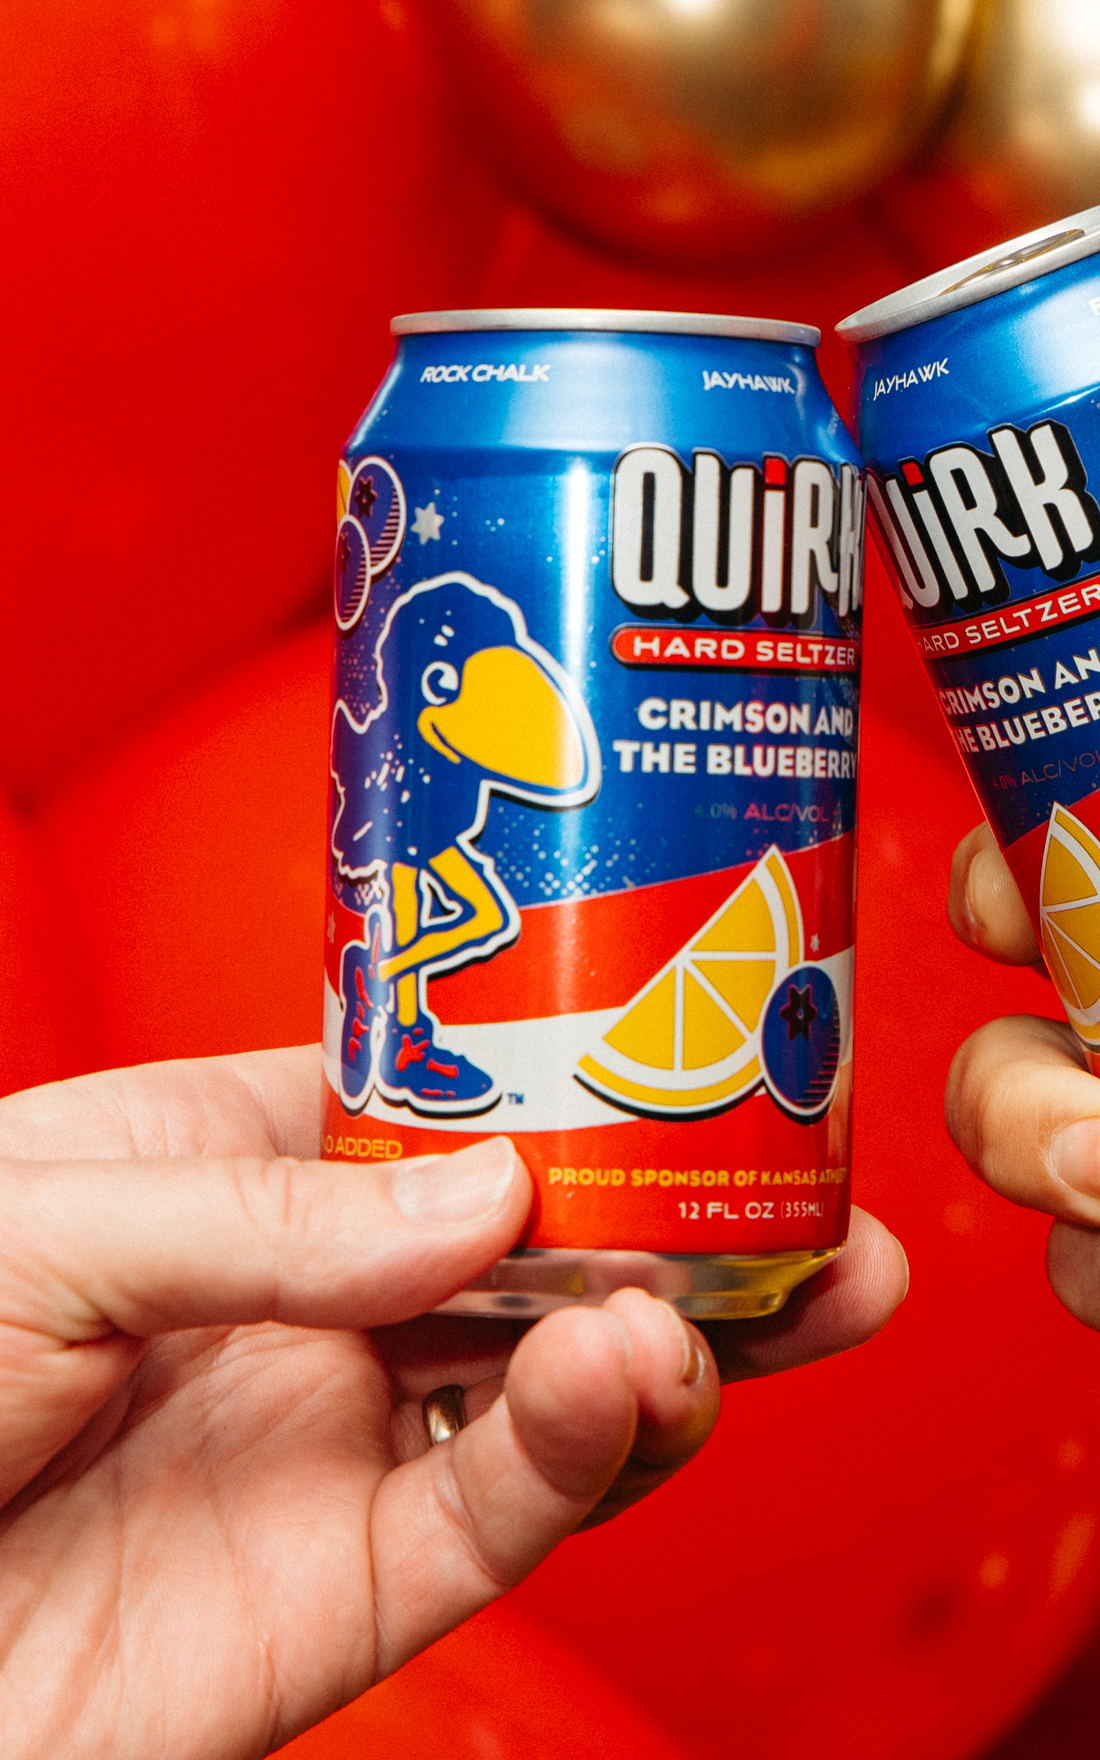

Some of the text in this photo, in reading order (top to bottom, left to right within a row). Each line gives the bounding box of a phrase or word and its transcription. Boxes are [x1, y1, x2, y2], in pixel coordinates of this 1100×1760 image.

[420, 363, 551, 383] ROCK CHALK
[702, 370, 796, 394] JAYHAWK
[873, 358, 950, 401] JAYHAWK
[633, 636, 855, 667] HARD SELTZER
[938, 667, 1047, 716] CRIMSON
[637, 697, 854, 736] CRIMSON AND
[951, 726, 980, 753] HE
[612, 740, 858, 779] THE BLUEBERRY
[743, 802, 829, 822] ALC/VOL
[335, 1136, 403, 1159] ADDED
[548, 1167, 626, 1186] PROUD
[630, 1168, 730, 1187] SPONSOR
[733, 1169, 758, 1187] OF
[761, 1168, 817, 1186] KANSAS
[678, 1200, 825, 1219] 12 FL OZ (355ML)
